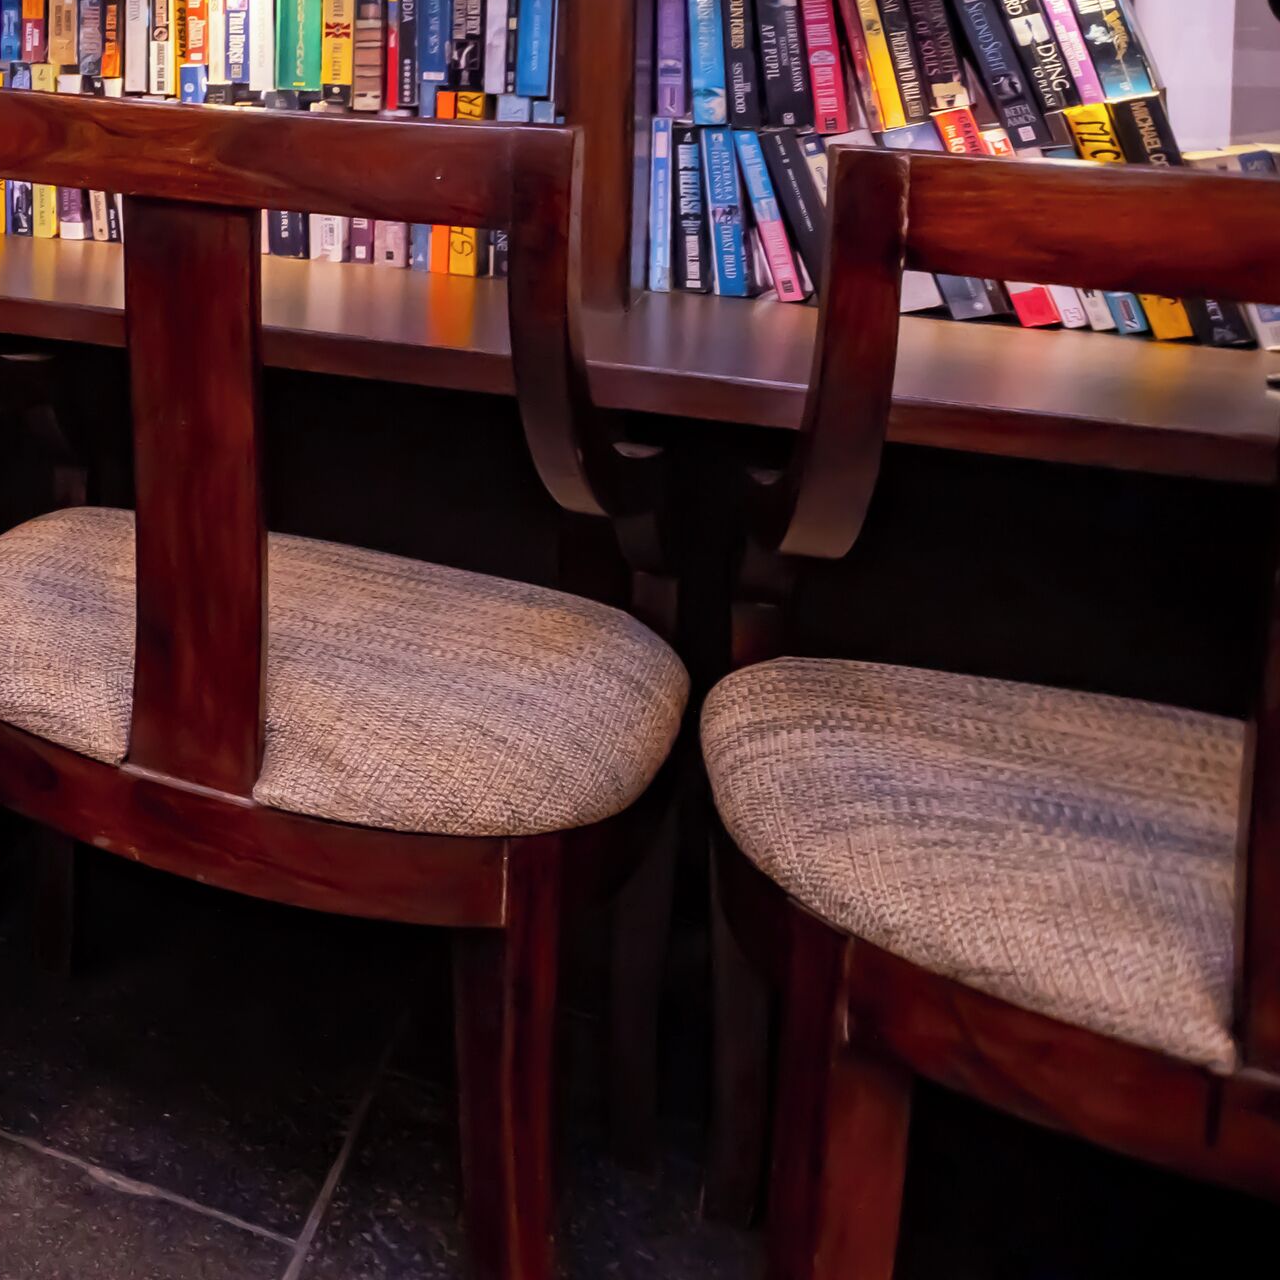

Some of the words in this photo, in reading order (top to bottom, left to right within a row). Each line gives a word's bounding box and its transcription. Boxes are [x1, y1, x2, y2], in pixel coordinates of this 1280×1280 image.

[731, 19, 745, 49] FORBES
[761, 24, 776, 44] APT
[785, 10, 801, 55] DIFFERENT
[764, 49, 780, 80] PUPIL
[888, 31, 915, 70] FREEDOM
[917, 40, 939, 76] SOULS
[935, 31, 957, 73] NORTH
[977, 42, 1006, 71] SIGHT
[790, 57, 804, 92] SEASONS
[900, 71, 916, 81] TO
[1032, 66, 1043, 77] TO
[1036, 44, 1070, 91] DYING
[732, 63, 746, 113] SISTERHOOD
[901, 82, 923, 101] KILL
[1036, 79, 1056, 106] PLEASE
[1130, 102, 1161, 149] MICHAEL
[711, 151, 723, 200] DELINSKY
[721, 152, 734, 200] BARBARA
[720, 225, 734, 253] COAST
[724, 254, 737, 279] ROAD
